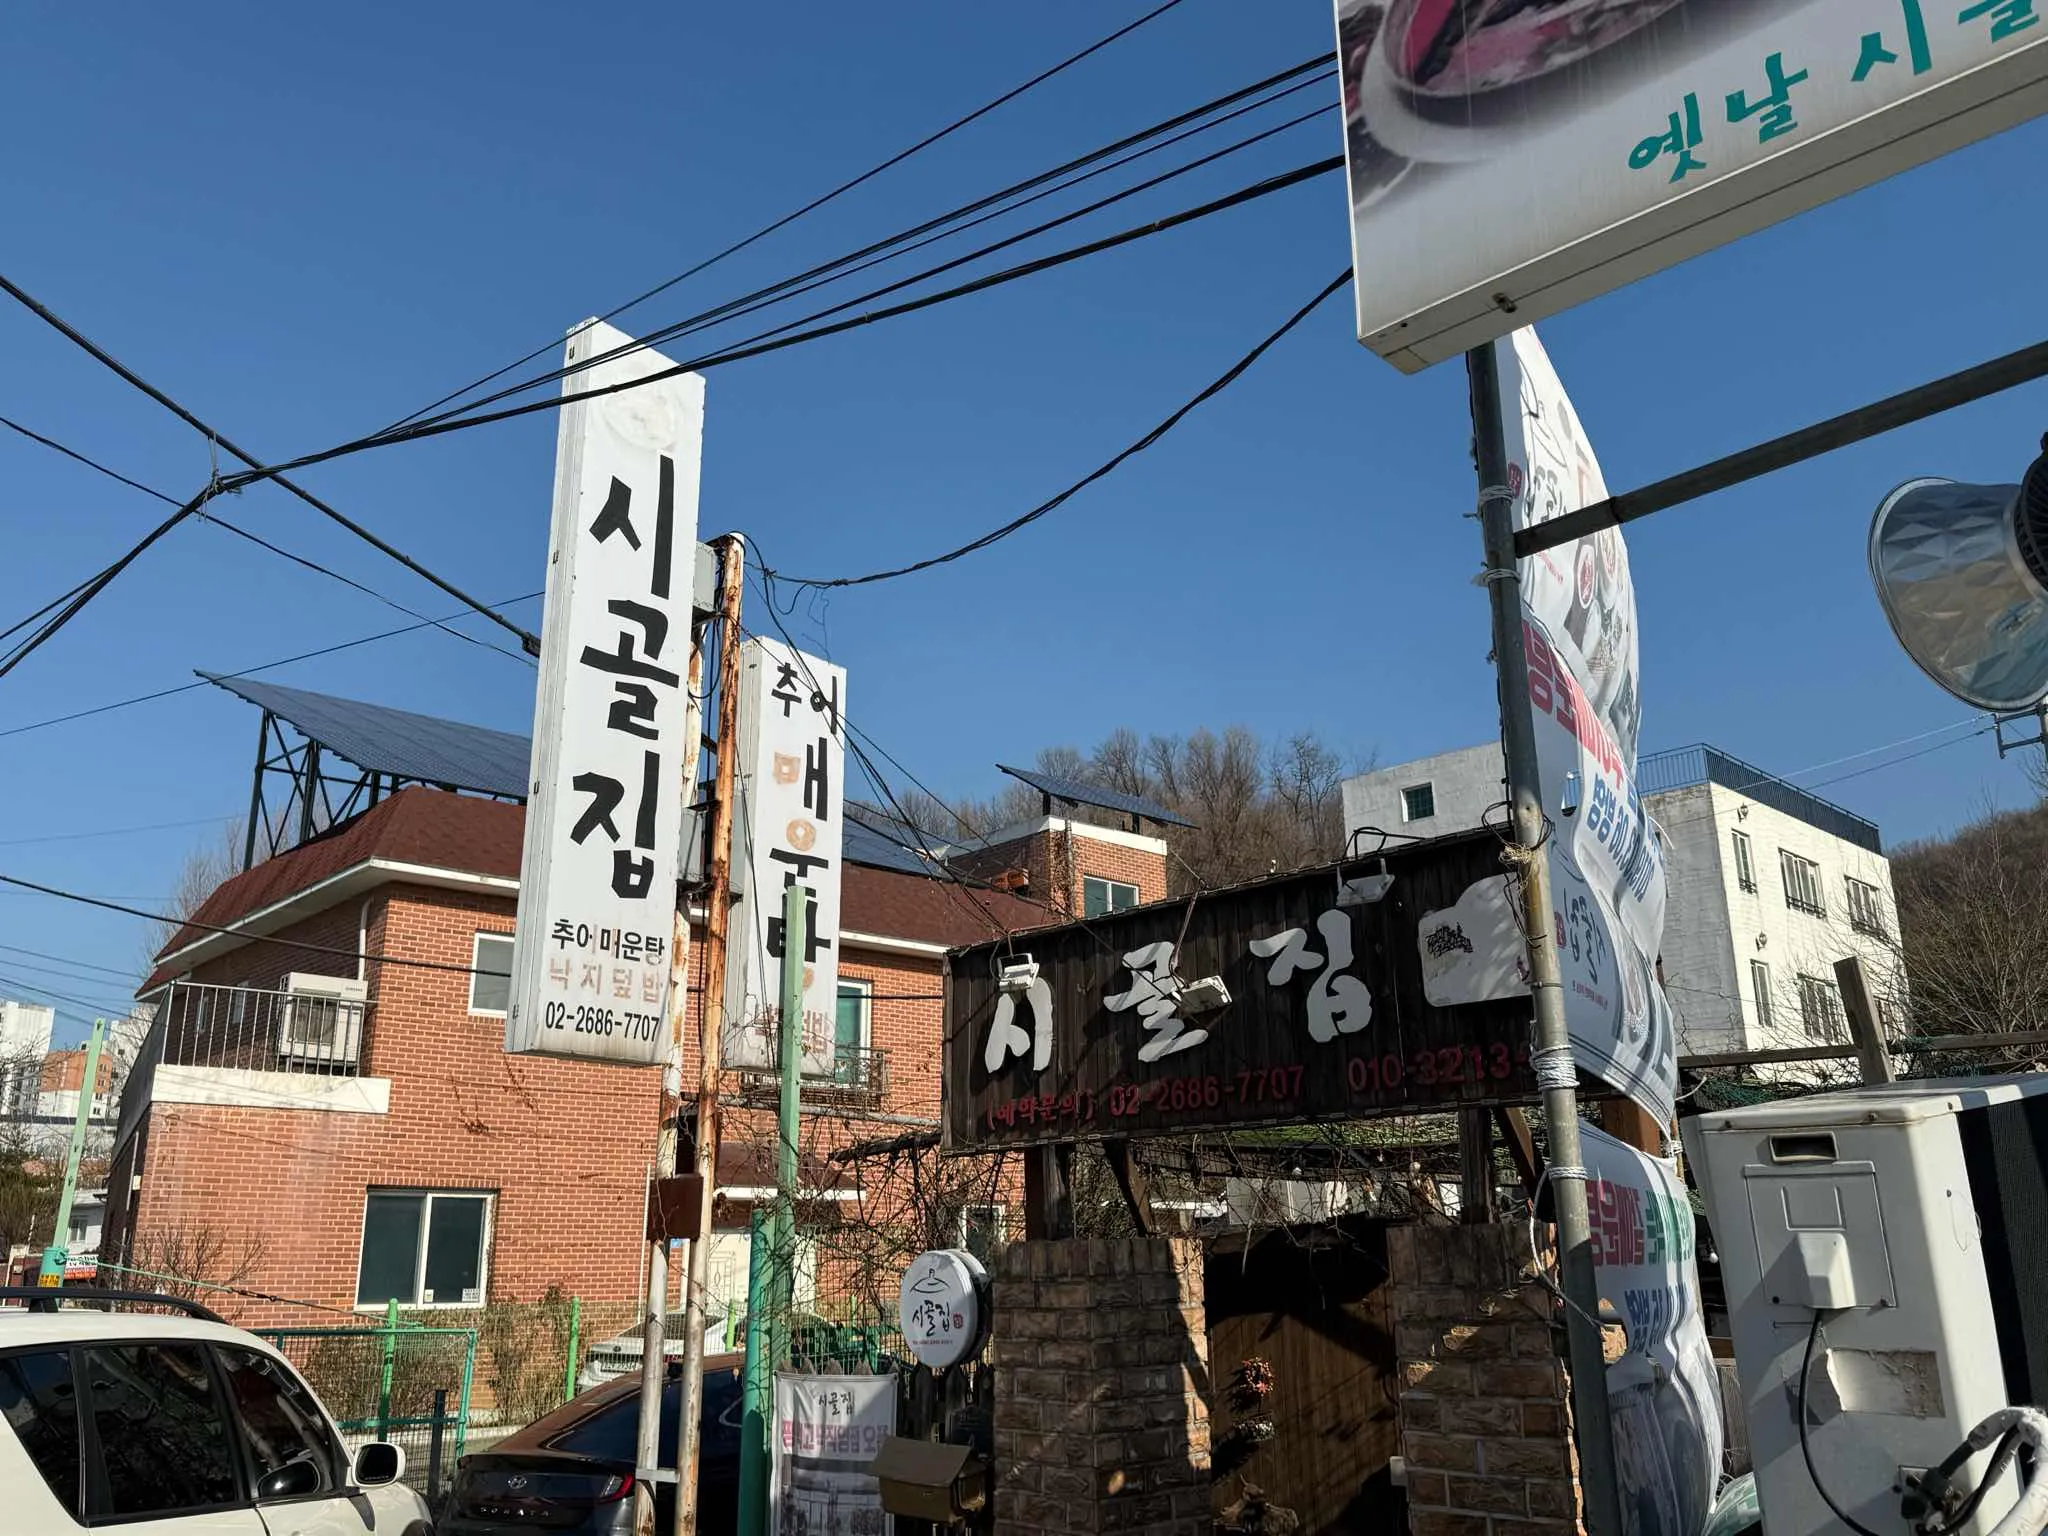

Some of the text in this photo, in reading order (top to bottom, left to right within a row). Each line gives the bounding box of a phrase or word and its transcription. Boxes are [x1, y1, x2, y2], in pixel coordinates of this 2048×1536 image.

[1627, 52, 1809, 184] 옛날
[570, 454, 680, 899] 시골집
[771, 662, 838, 735] 추어
[546, 1001, 660, 1043] 02-2686-7707
[985, 909, 1372, 1074] 시골집
[1110, 1065, 1305, 1118] 02-2686-7707
[911, 1299, 950, 1337] 시골집
[817, 1391, 855, 1416] 시골집
